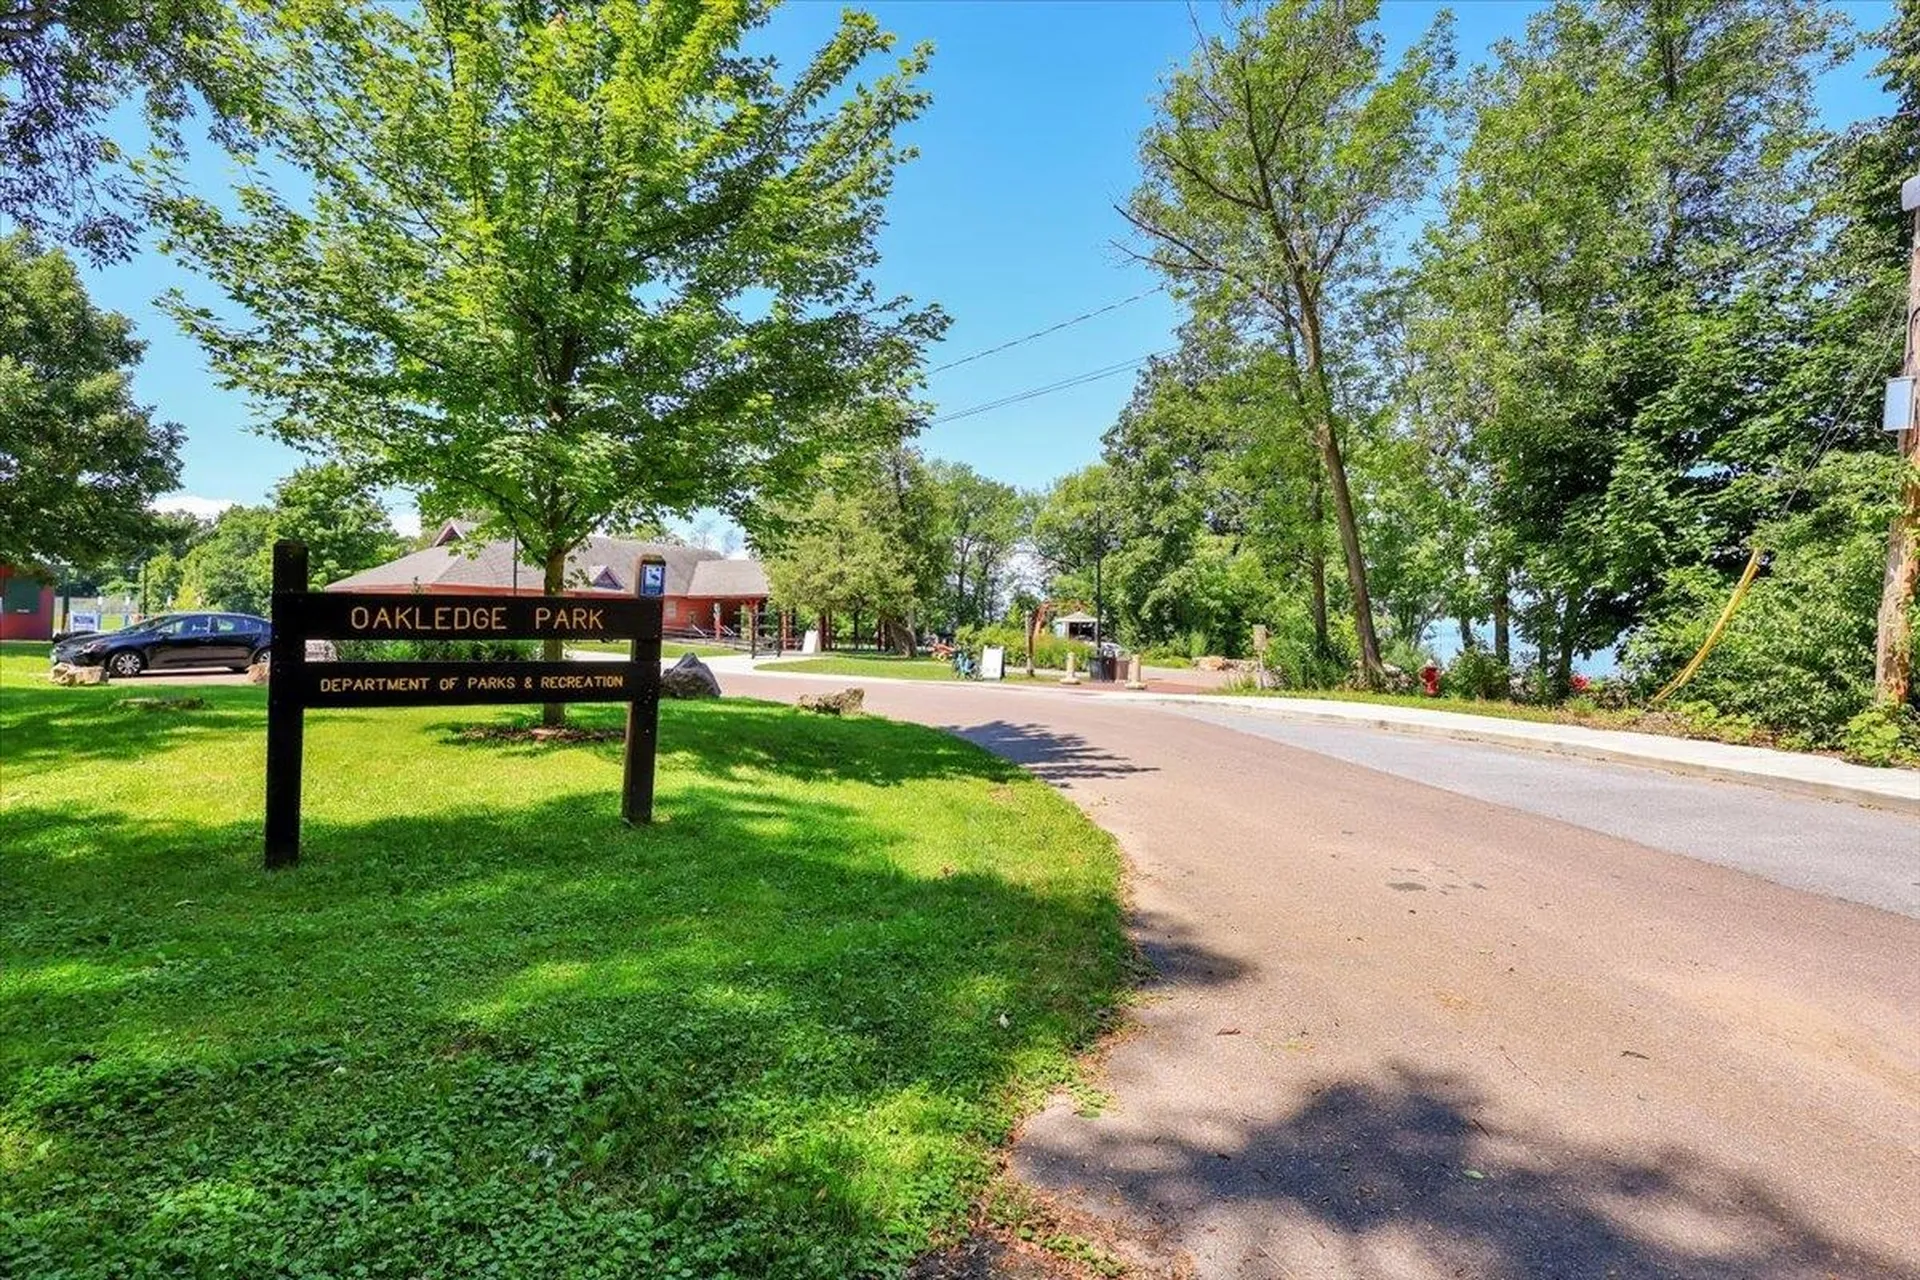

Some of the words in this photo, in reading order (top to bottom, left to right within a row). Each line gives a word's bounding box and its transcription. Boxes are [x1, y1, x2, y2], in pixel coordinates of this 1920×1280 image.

[351, 606, 507, 630] OAKLEDGE
[535, 607, 605, 630] PARK
[320, 677, 429, 692] DEPARTMENT
[439, 677, 459, 691] OF
[467, 676, 516, 690] PARKS
[523, 676, 533, 689] &
[540, 675, 625, 690] RECREATION
